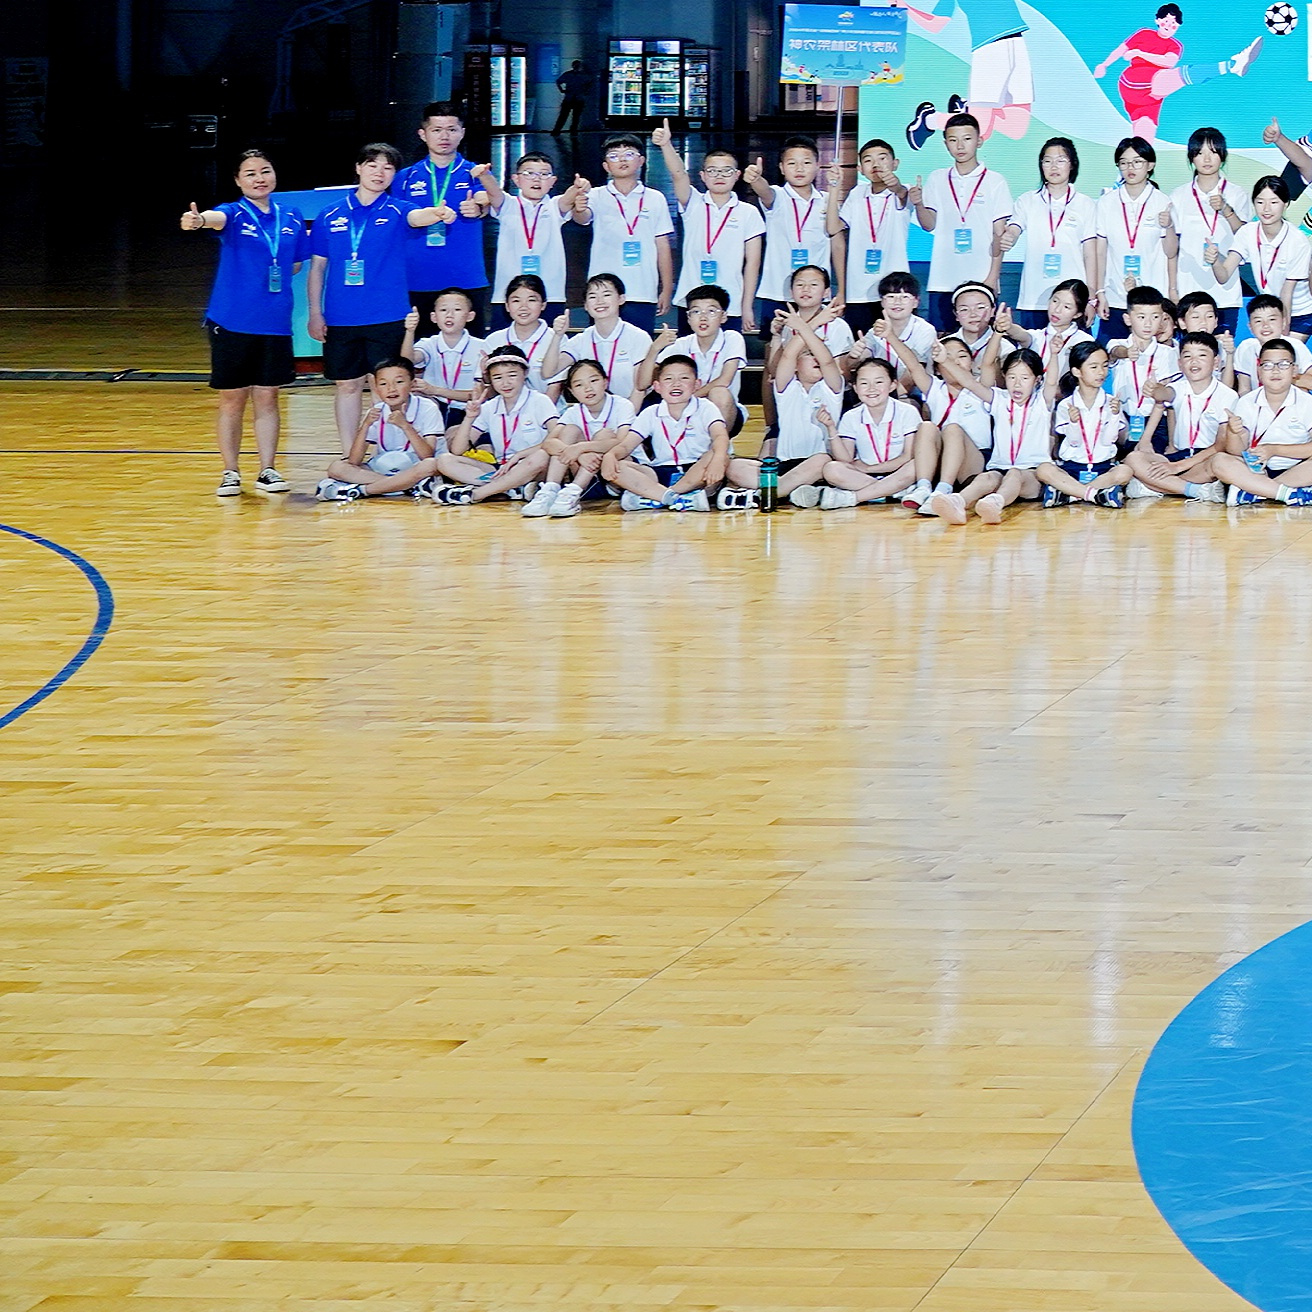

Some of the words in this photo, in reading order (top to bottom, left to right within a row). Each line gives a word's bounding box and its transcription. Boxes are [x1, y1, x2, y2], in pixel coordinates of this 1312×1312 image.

[788, 38, 898, 53] 神农架林区代表队
